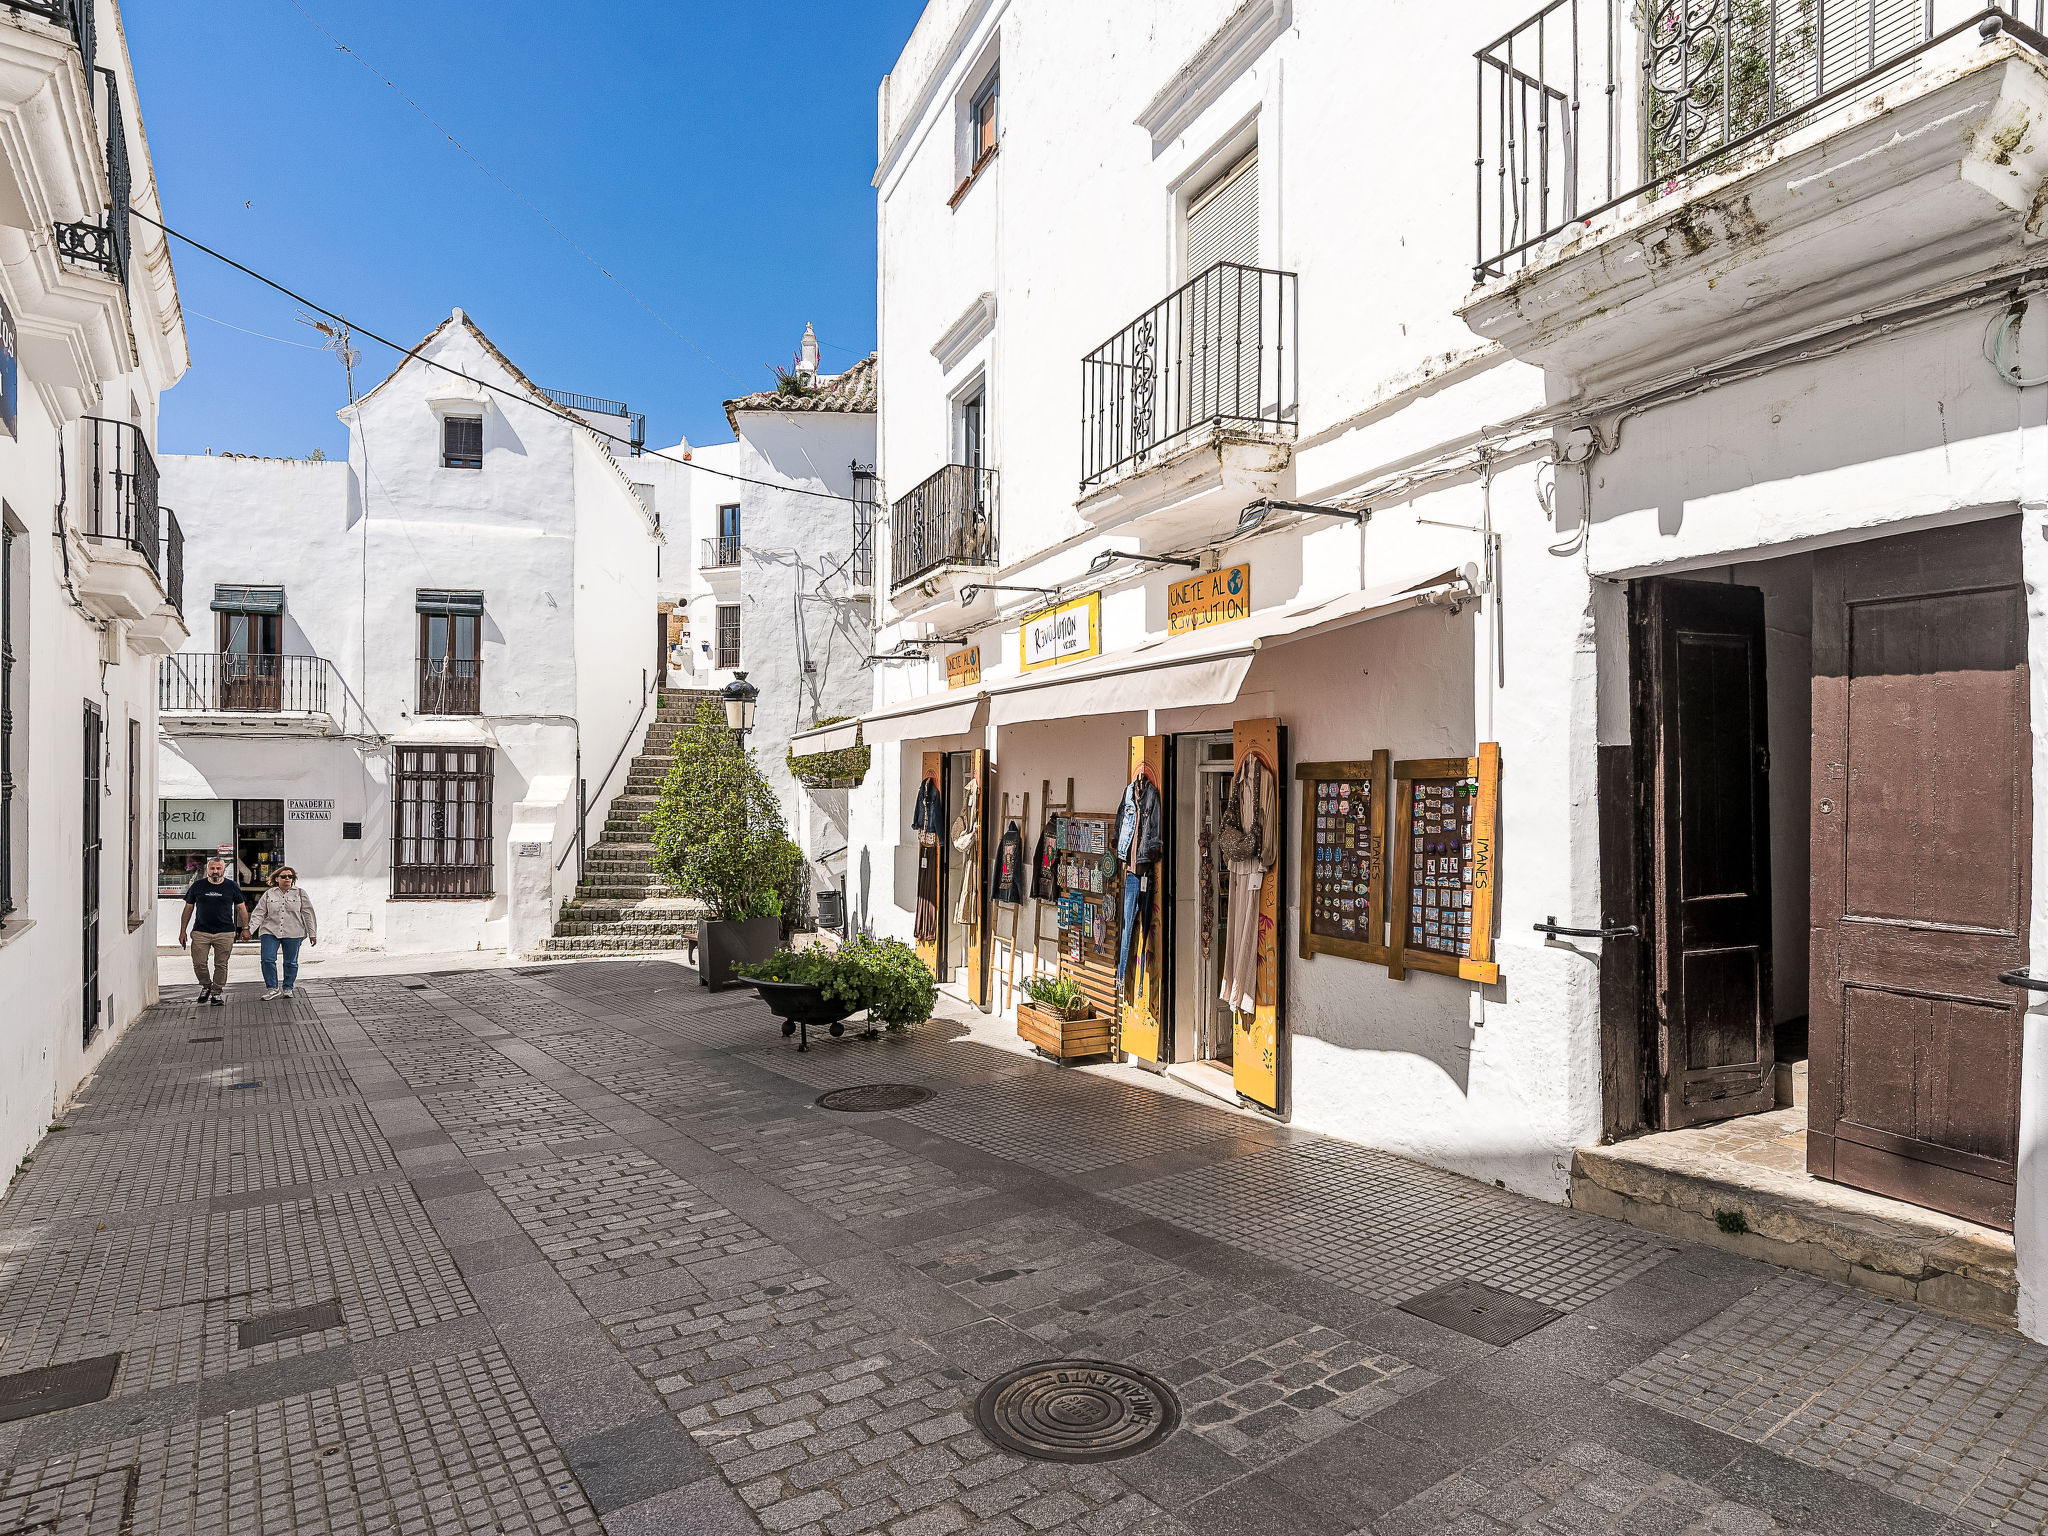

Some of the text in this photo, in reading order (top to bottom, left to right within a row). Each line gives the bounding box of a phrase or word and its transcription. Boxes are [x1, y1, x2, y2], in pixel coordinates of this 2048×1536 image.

[1212, 575, 1225, 598] AL
[290, 800, 333, 809] PANADERIA
[291, 812, 330, 820] PASTRANA
[1371, 835, 1382, 880] IMANES
[1475, 838, 1490, 889] IMANES
[1056, 1371, 1153, 1426] SANEAMIENTO
